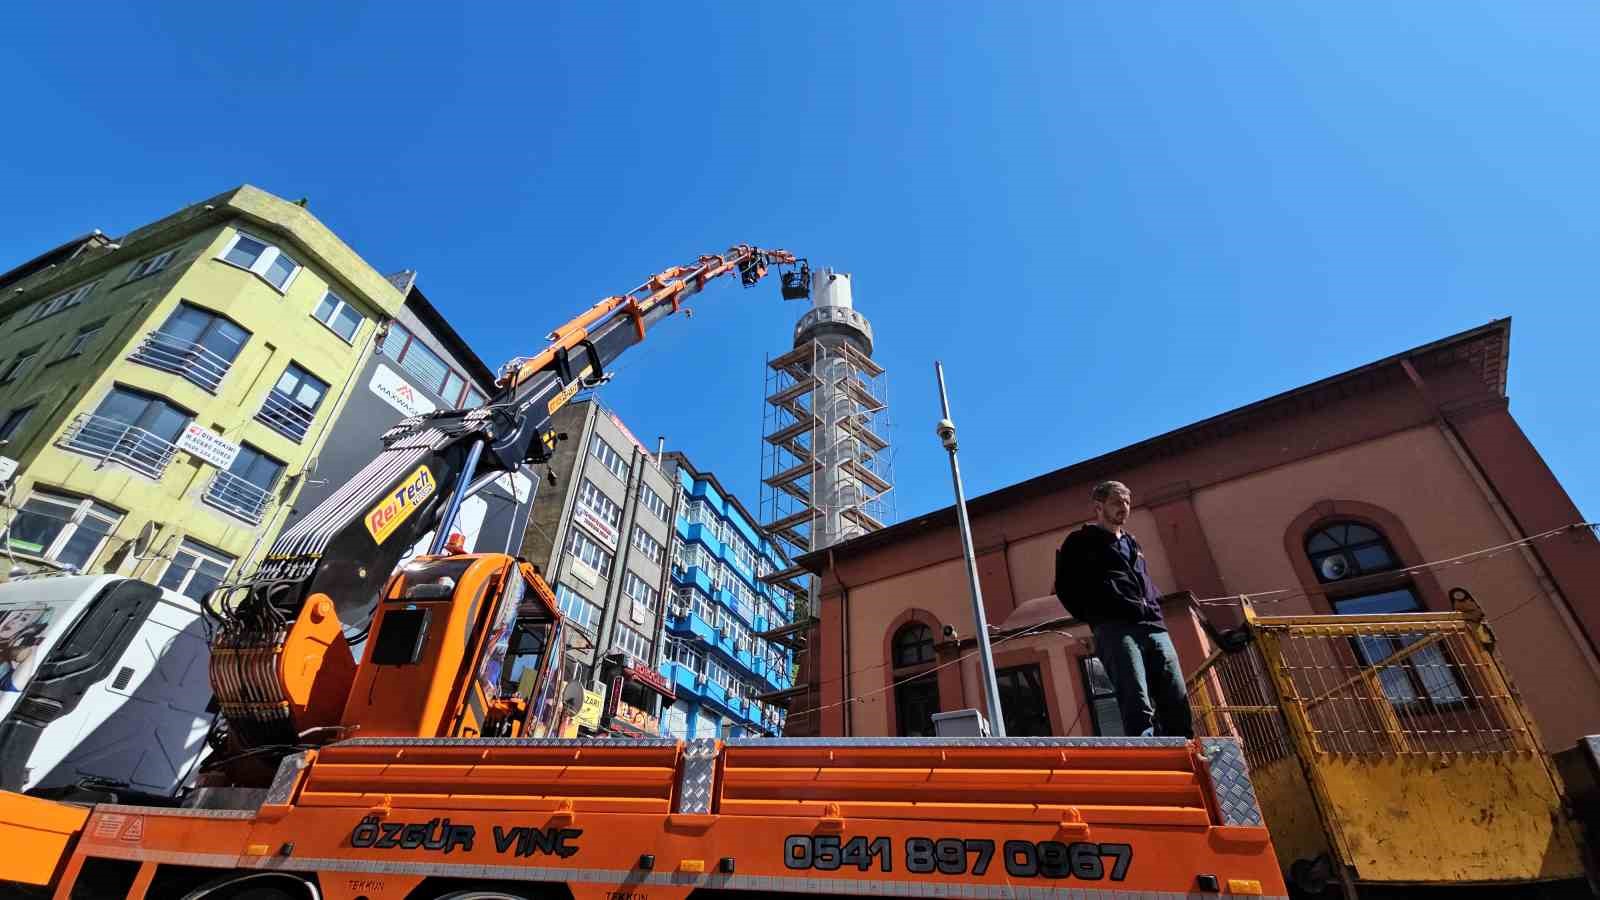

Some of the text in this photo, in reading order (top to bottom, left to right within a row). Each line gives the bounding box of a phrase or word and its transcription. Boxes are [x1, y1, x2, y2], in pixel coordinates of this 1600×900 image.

[352, 815, 475, 853] ÖZGÜR
[784, 834, 893, 872] 0541
[905, 837, 996, 876] 897
